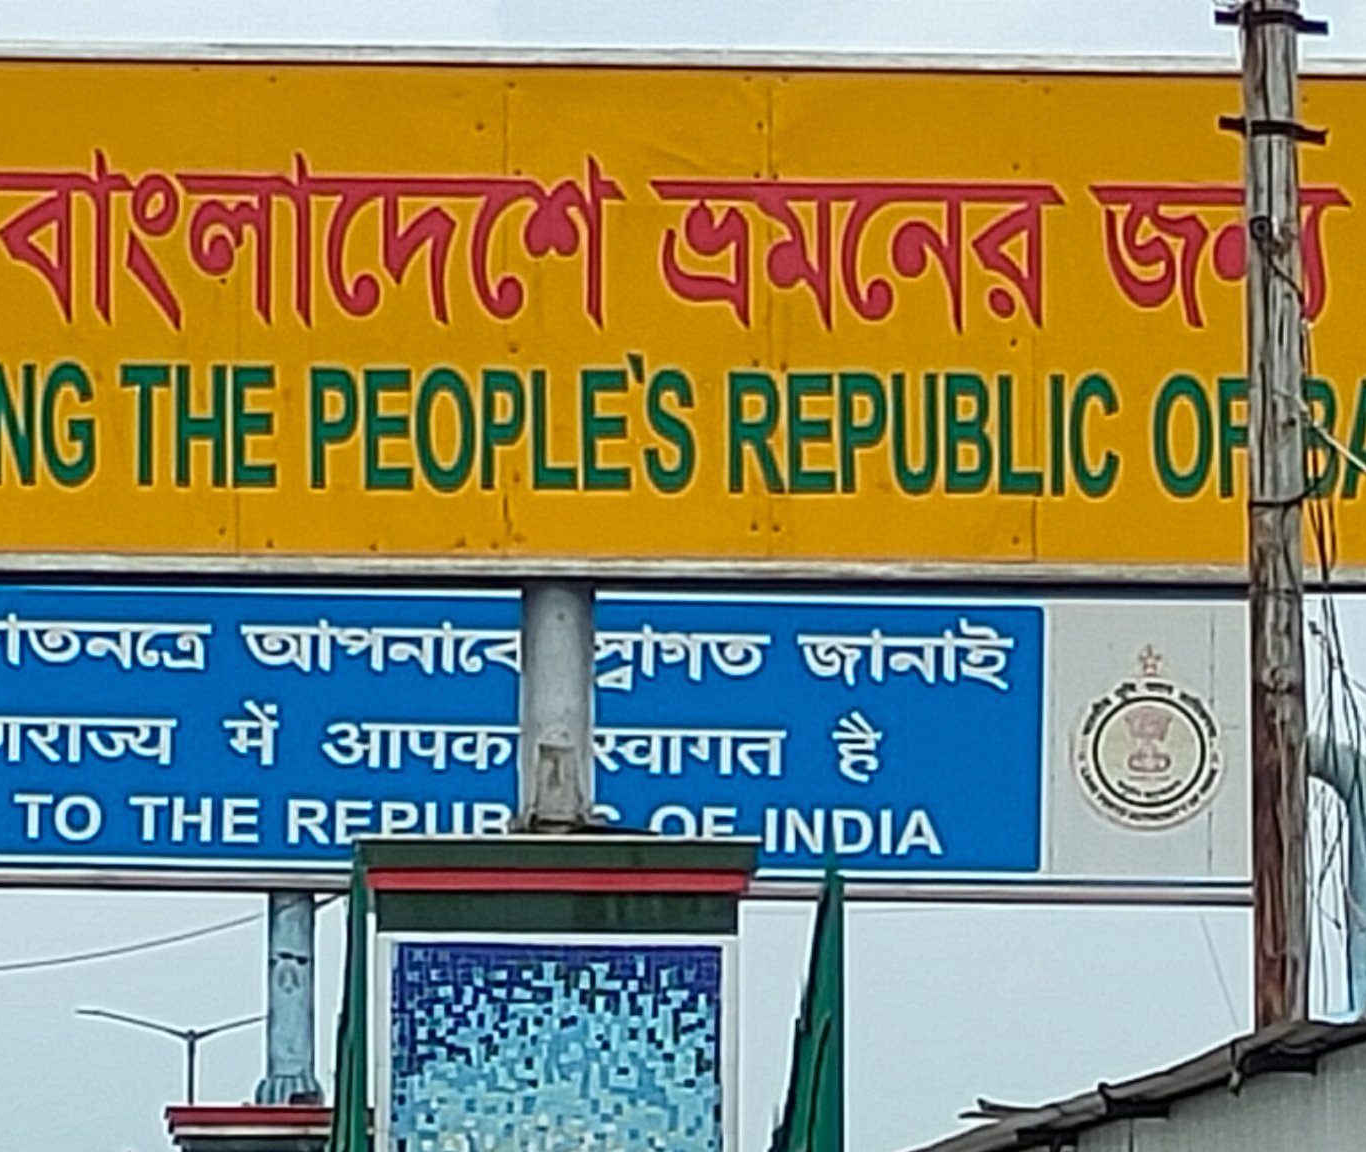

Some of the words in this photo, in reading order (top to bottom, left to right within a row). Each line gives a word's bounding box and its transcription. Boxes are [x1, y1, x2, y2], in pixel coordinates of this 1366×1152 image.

[649, 178, 1064, 330] ভ্রমনের
[121, 365, 275, 487] THE
[728, 372, 1119, 497] REPUBLIC
[1154, 374, 1250, 498] OF
[797, 618, 1014, 690] জানাই
[223, 701, 279, 765] में
[322, 722, 522, 770] आपक
[831, 711, 883, 783] है
[13, 793, 102, 839] TO
[130, 797, 260, 843] THE
[287, 799, 621, 844] REPUB
[649, 805, 739, 838] OF
[764, 808, 943, 855] INDIA
